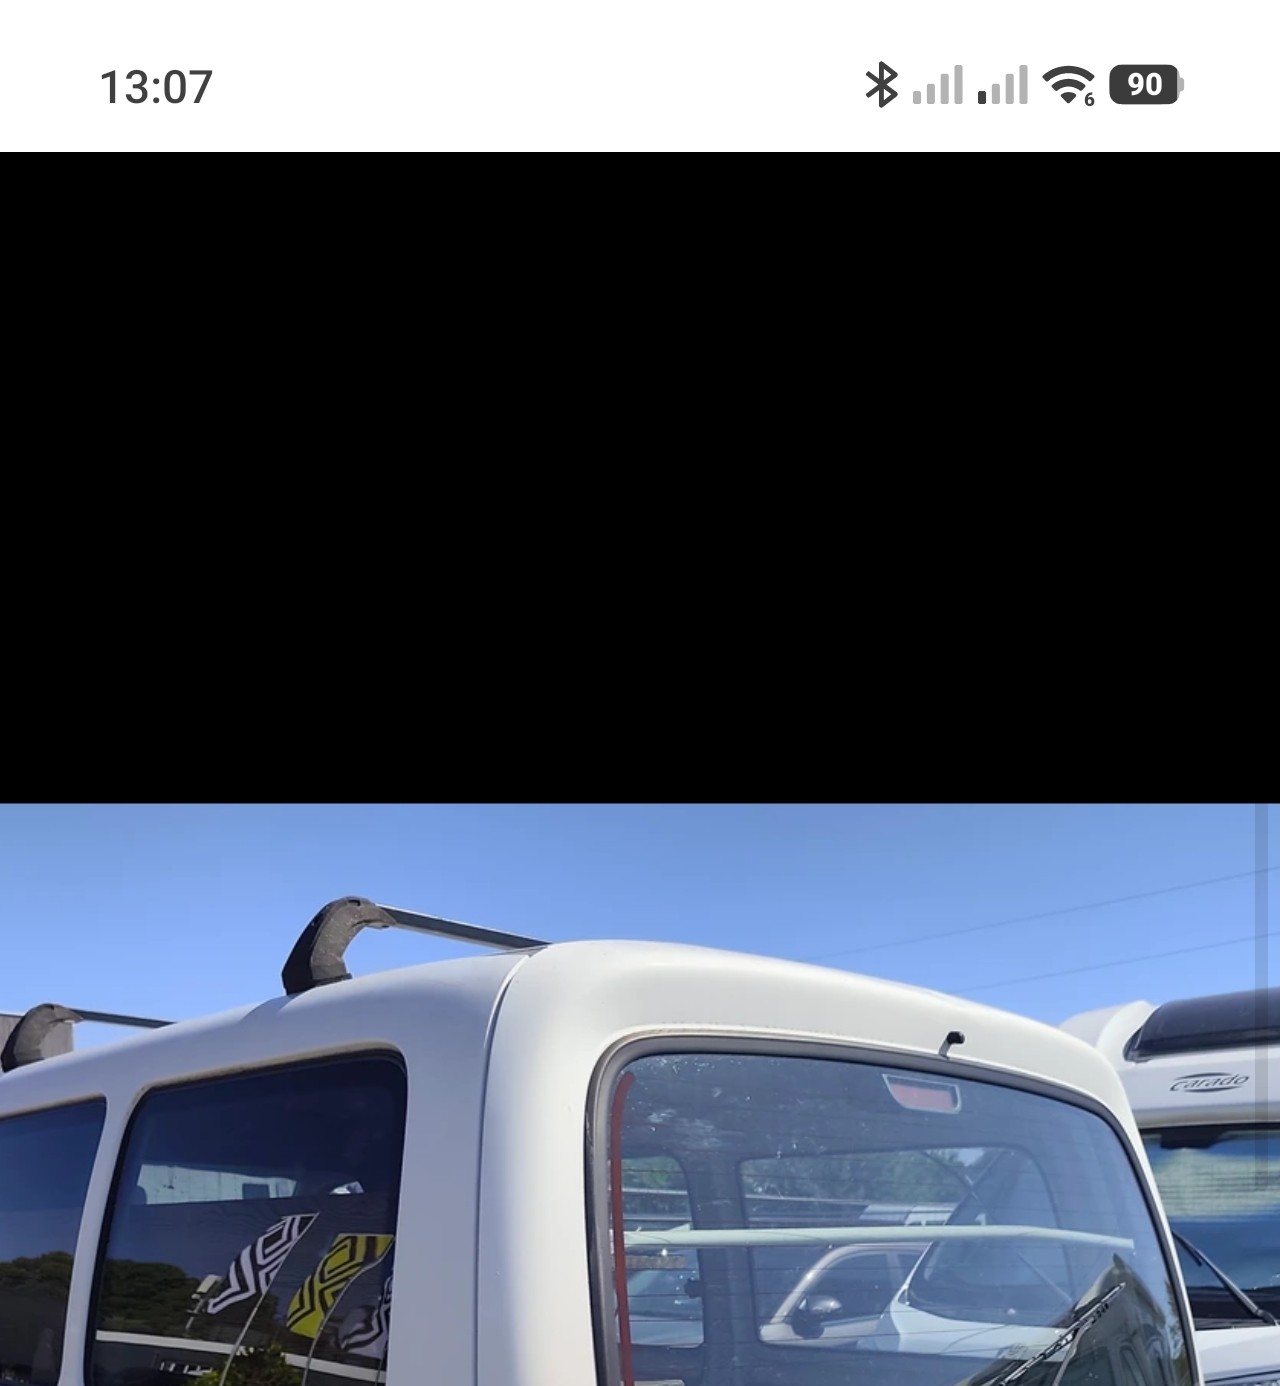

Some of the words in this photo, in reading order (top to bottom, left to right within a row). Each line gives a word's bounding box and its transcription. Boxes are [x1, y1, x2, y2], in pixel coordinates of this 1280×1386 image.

[102, 70, 213, 104] 13:07
[1127, 72, 1163, 96] 90
[1084, 92, 1095, 107] 6
